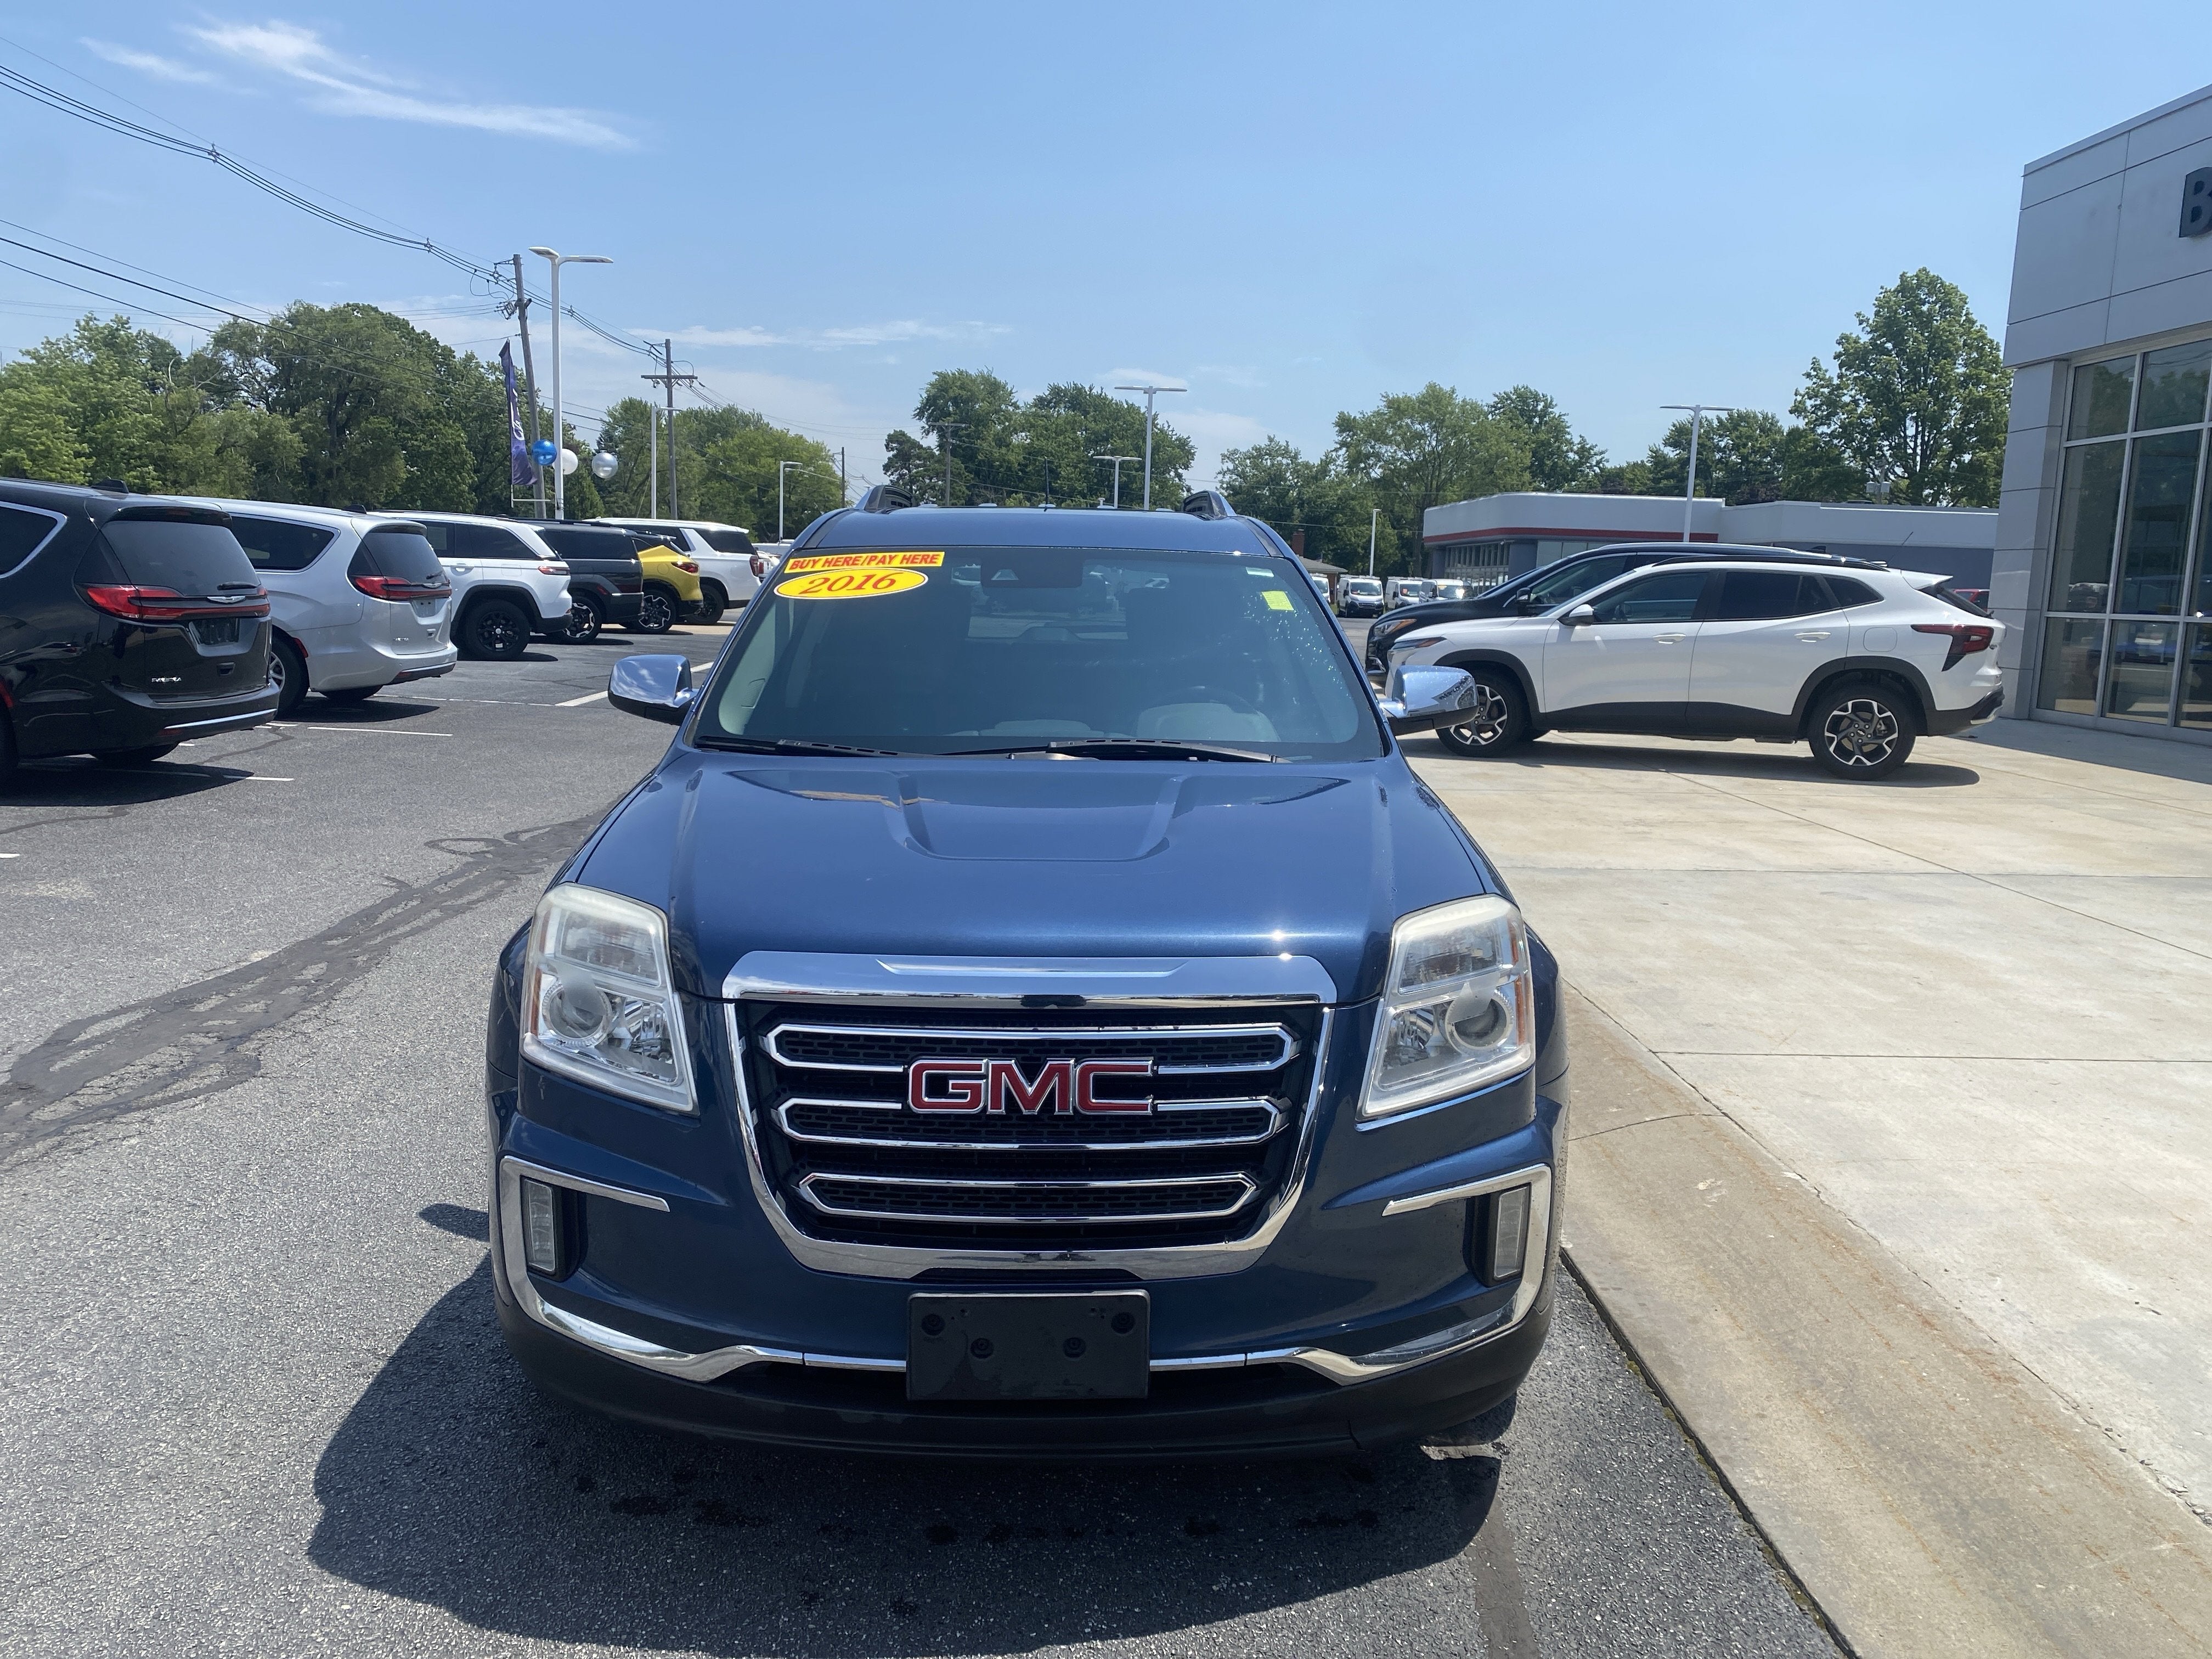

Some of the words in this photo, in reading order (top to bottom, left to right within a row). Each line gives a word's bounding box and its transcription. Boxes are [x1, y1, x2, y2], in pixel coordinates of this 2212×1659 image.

[789, 558, 823, 570] BUY
[823, 554, 898, 567] HERE/PAY
[900, 554, 940, 565] HERE
[798, 572, 904, 595] 2016
[909, 1057, 1154, 1115] GMC
